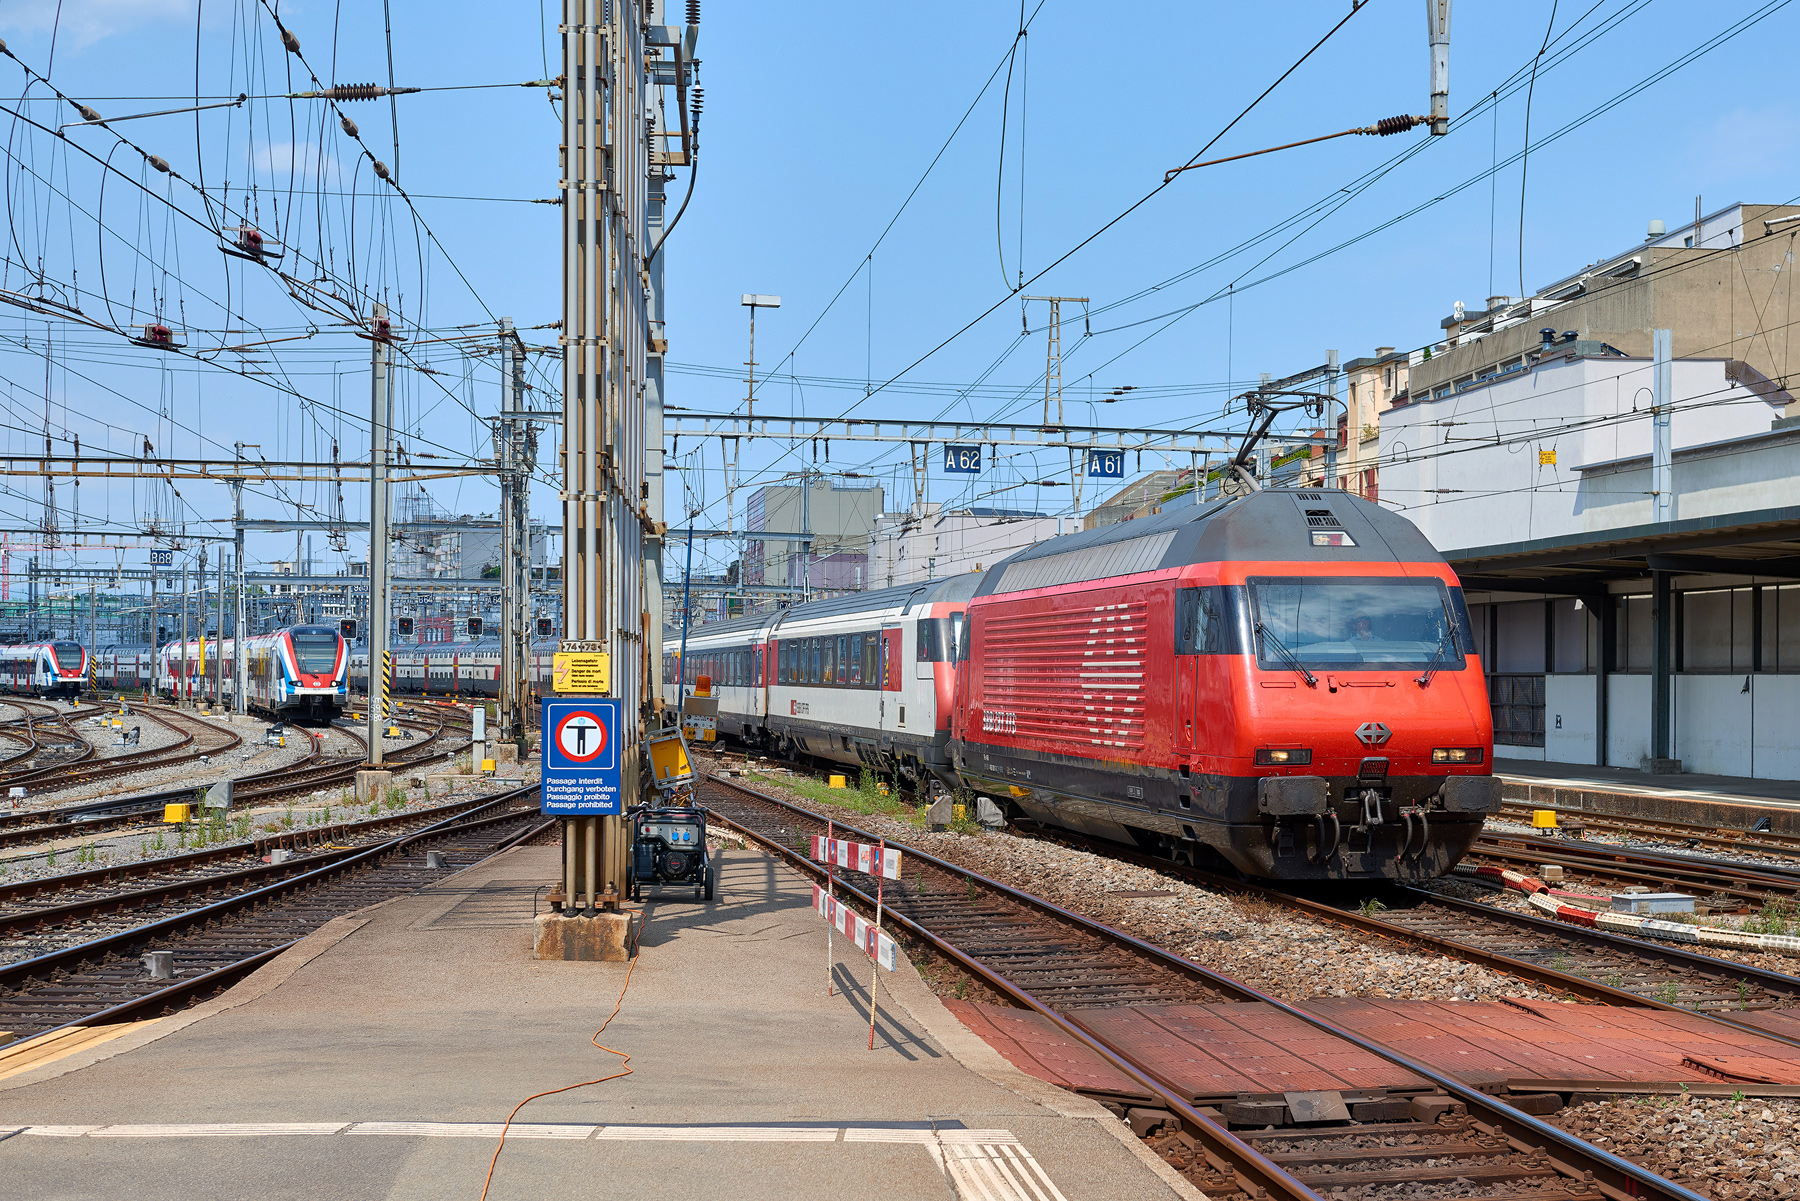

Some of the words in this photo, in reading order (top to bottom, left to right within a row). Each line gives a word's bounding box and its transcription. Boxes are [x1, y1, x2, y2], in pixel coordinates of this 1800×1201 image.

[946, 450, 956, 469] A
[960, 450, 980, 469] 62
[1091, 455, 1100, 473] A
[1105, 456, 1121, 474] 61
